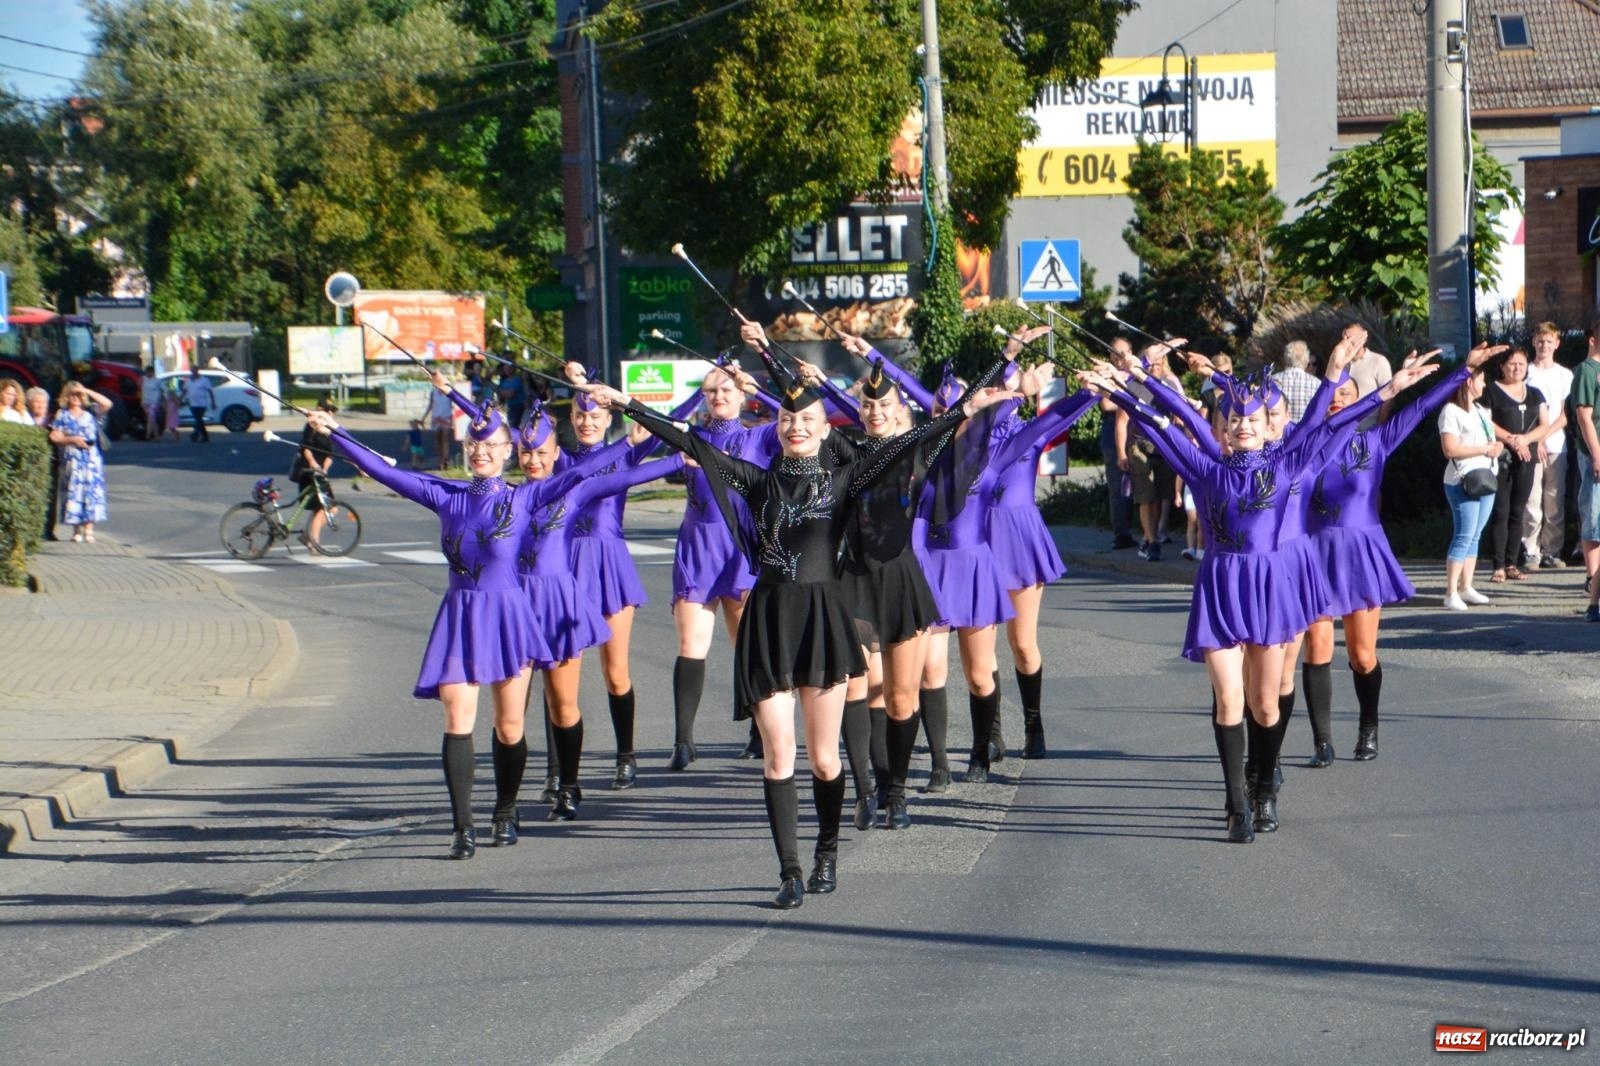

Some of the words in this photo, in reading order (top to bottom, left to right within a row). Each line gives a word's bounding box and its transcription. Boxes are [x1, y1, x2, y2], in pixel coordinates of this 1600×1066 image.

[1138, 79, 1174, 104] N
[1064, 152, 1117, 185] 604
[791, 214, 908, 263] ELLET
[628, 276, 692, 294] żabka
[824, 274, 865, 299] 506
[869, 273, 909, 298] 255
[638, 310, 681, 323] parking
